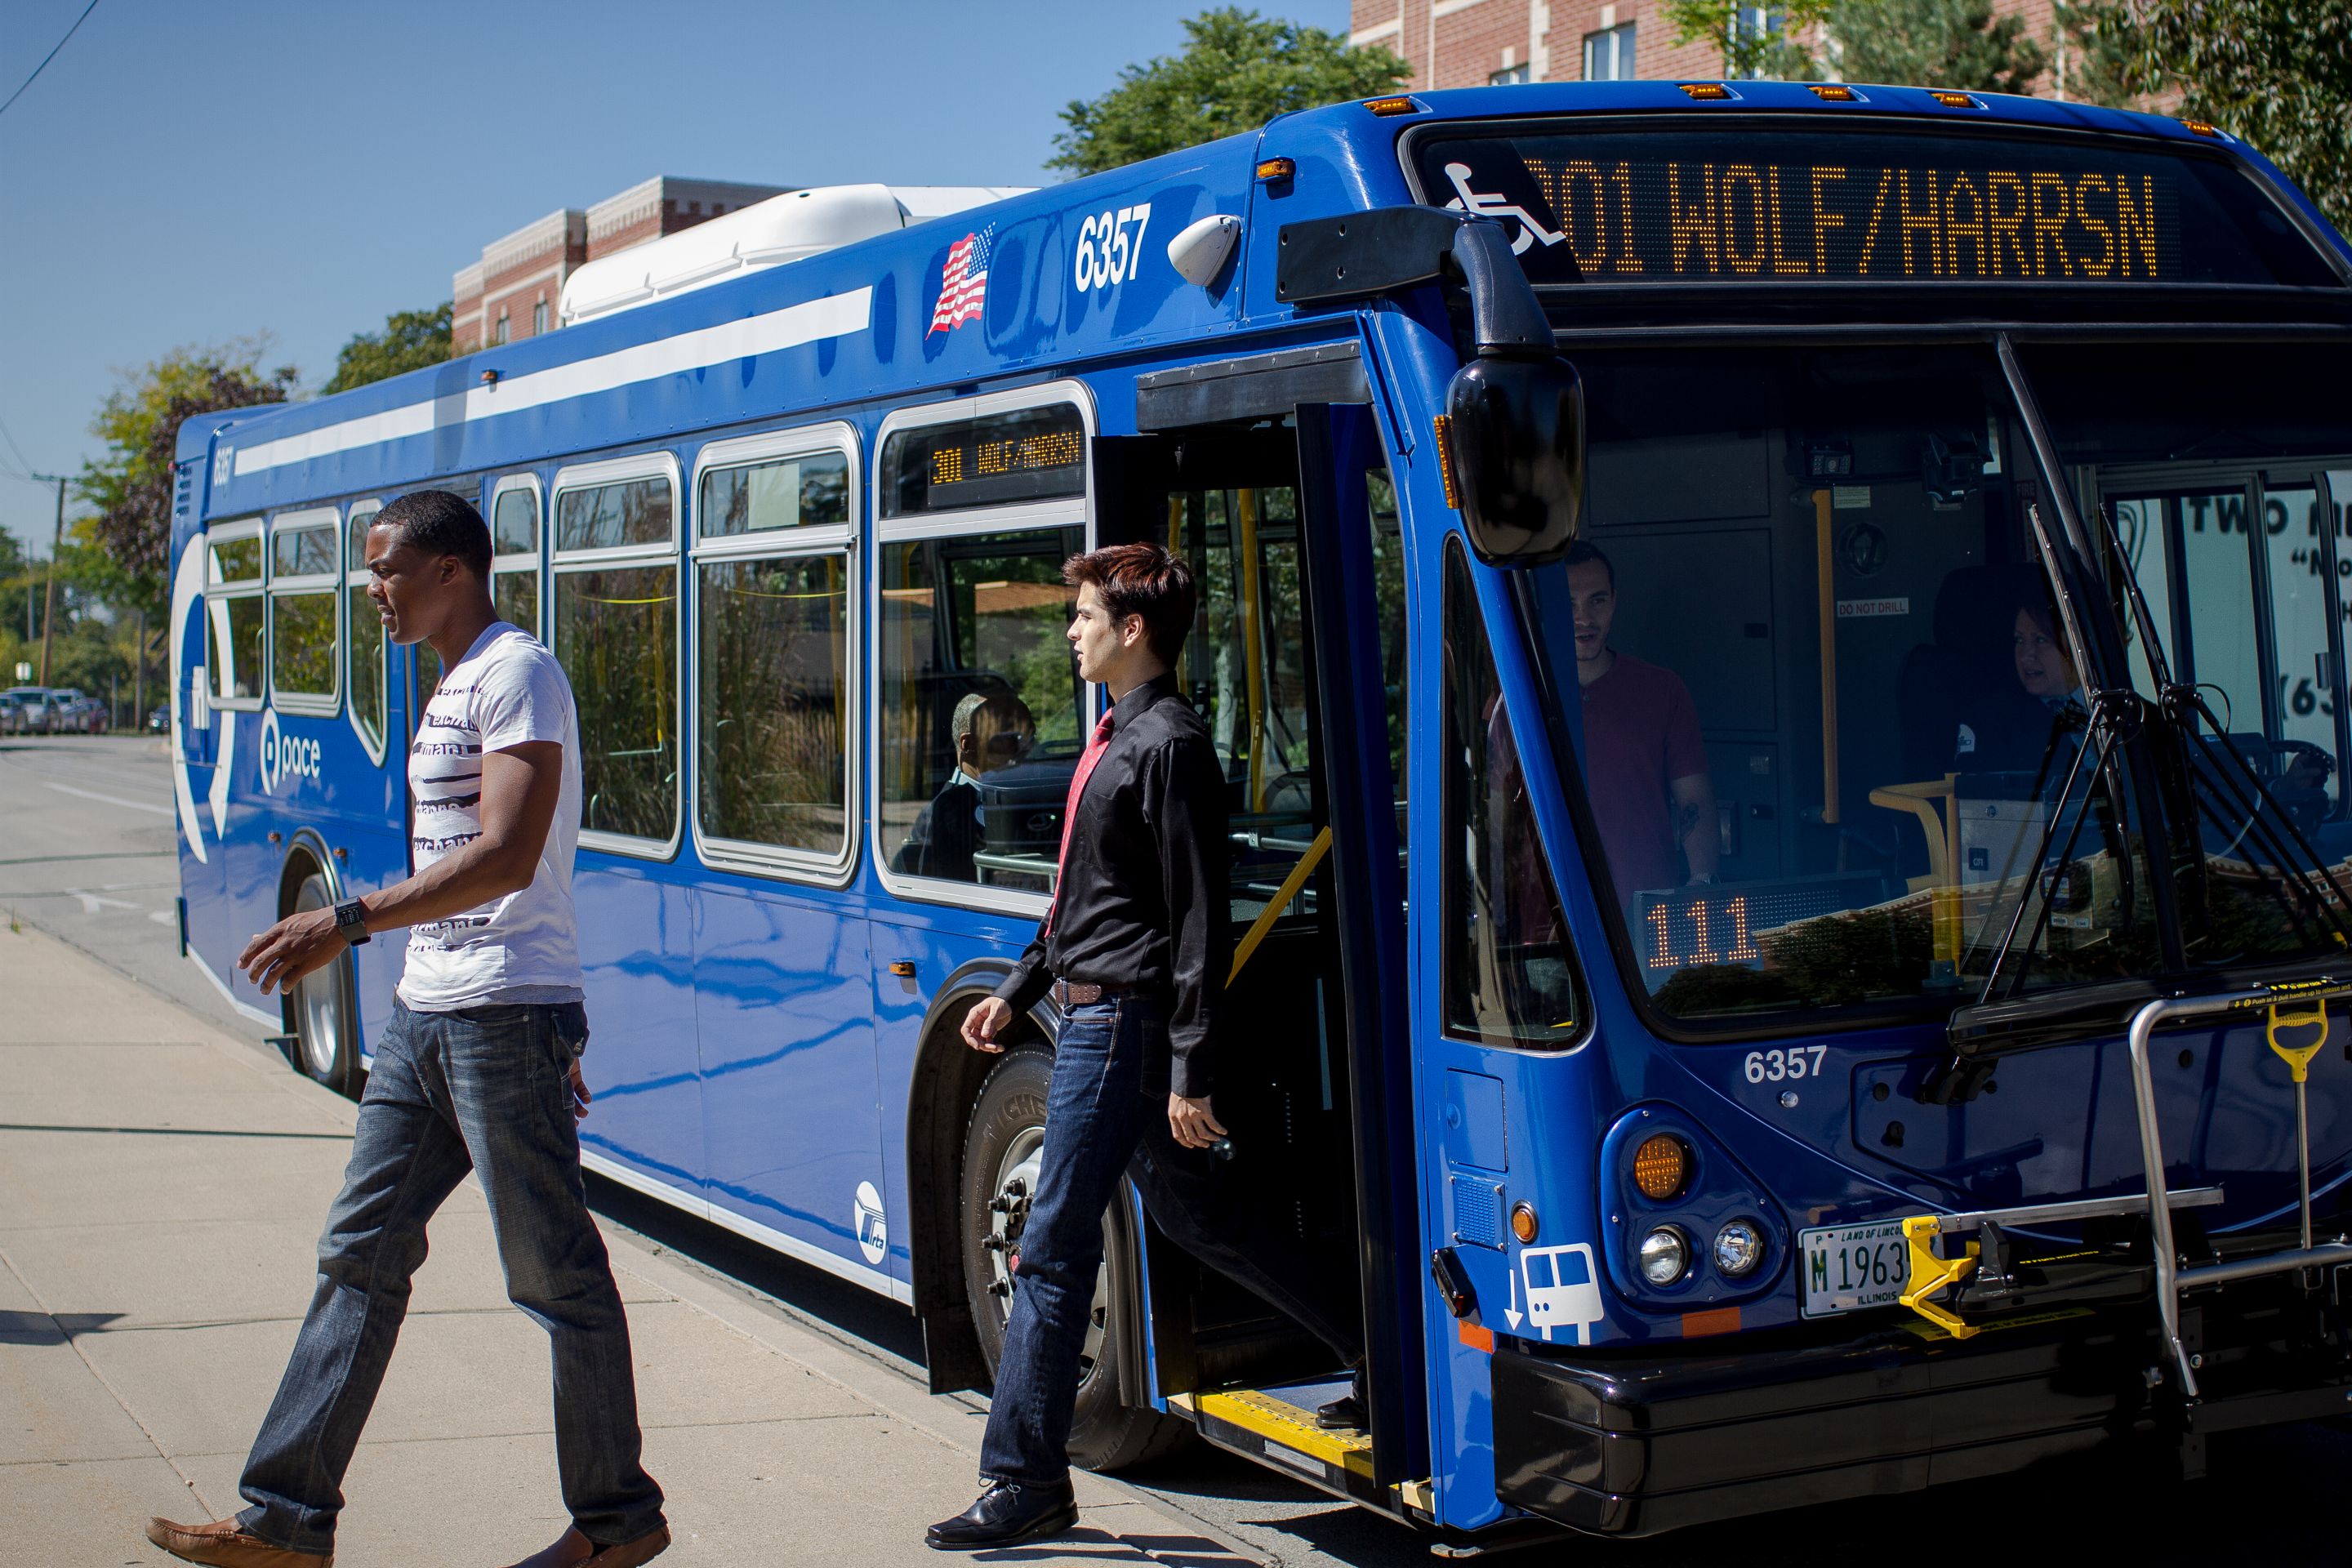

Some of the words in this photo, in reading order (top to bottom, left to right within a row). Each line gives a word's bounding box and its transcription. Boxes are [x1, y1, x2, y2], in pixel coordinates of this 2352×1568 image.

[1669, 163, 2158, 277] WOLF/HARRSN
[1075, 203, 1152, 292] 6357
[933, 448, 963, 484] 301
[978, 430, 1079, 474] WOLF/HARRSN
[2189, 497, 2288, 535] TWO
[1839, 604, 1853, 615] DO
[1855, 602, 1876, 614] NOT
[1878, 600, 1906, 613] DRILL
[282, 734, 321, 781] pace
[1648, 898, 1757, 968] 111
[1744, 1045, 1827, 1084] 6357
[1815, 1236, 1823, 1245] P
[1841, 1230, 1863, 1242] LAND
[1865, 1227, 1876, 1239] OF
[1811, 1249, 1828, 1293] M
[1857, 1290, 1897, 1305] ILLINOIS
